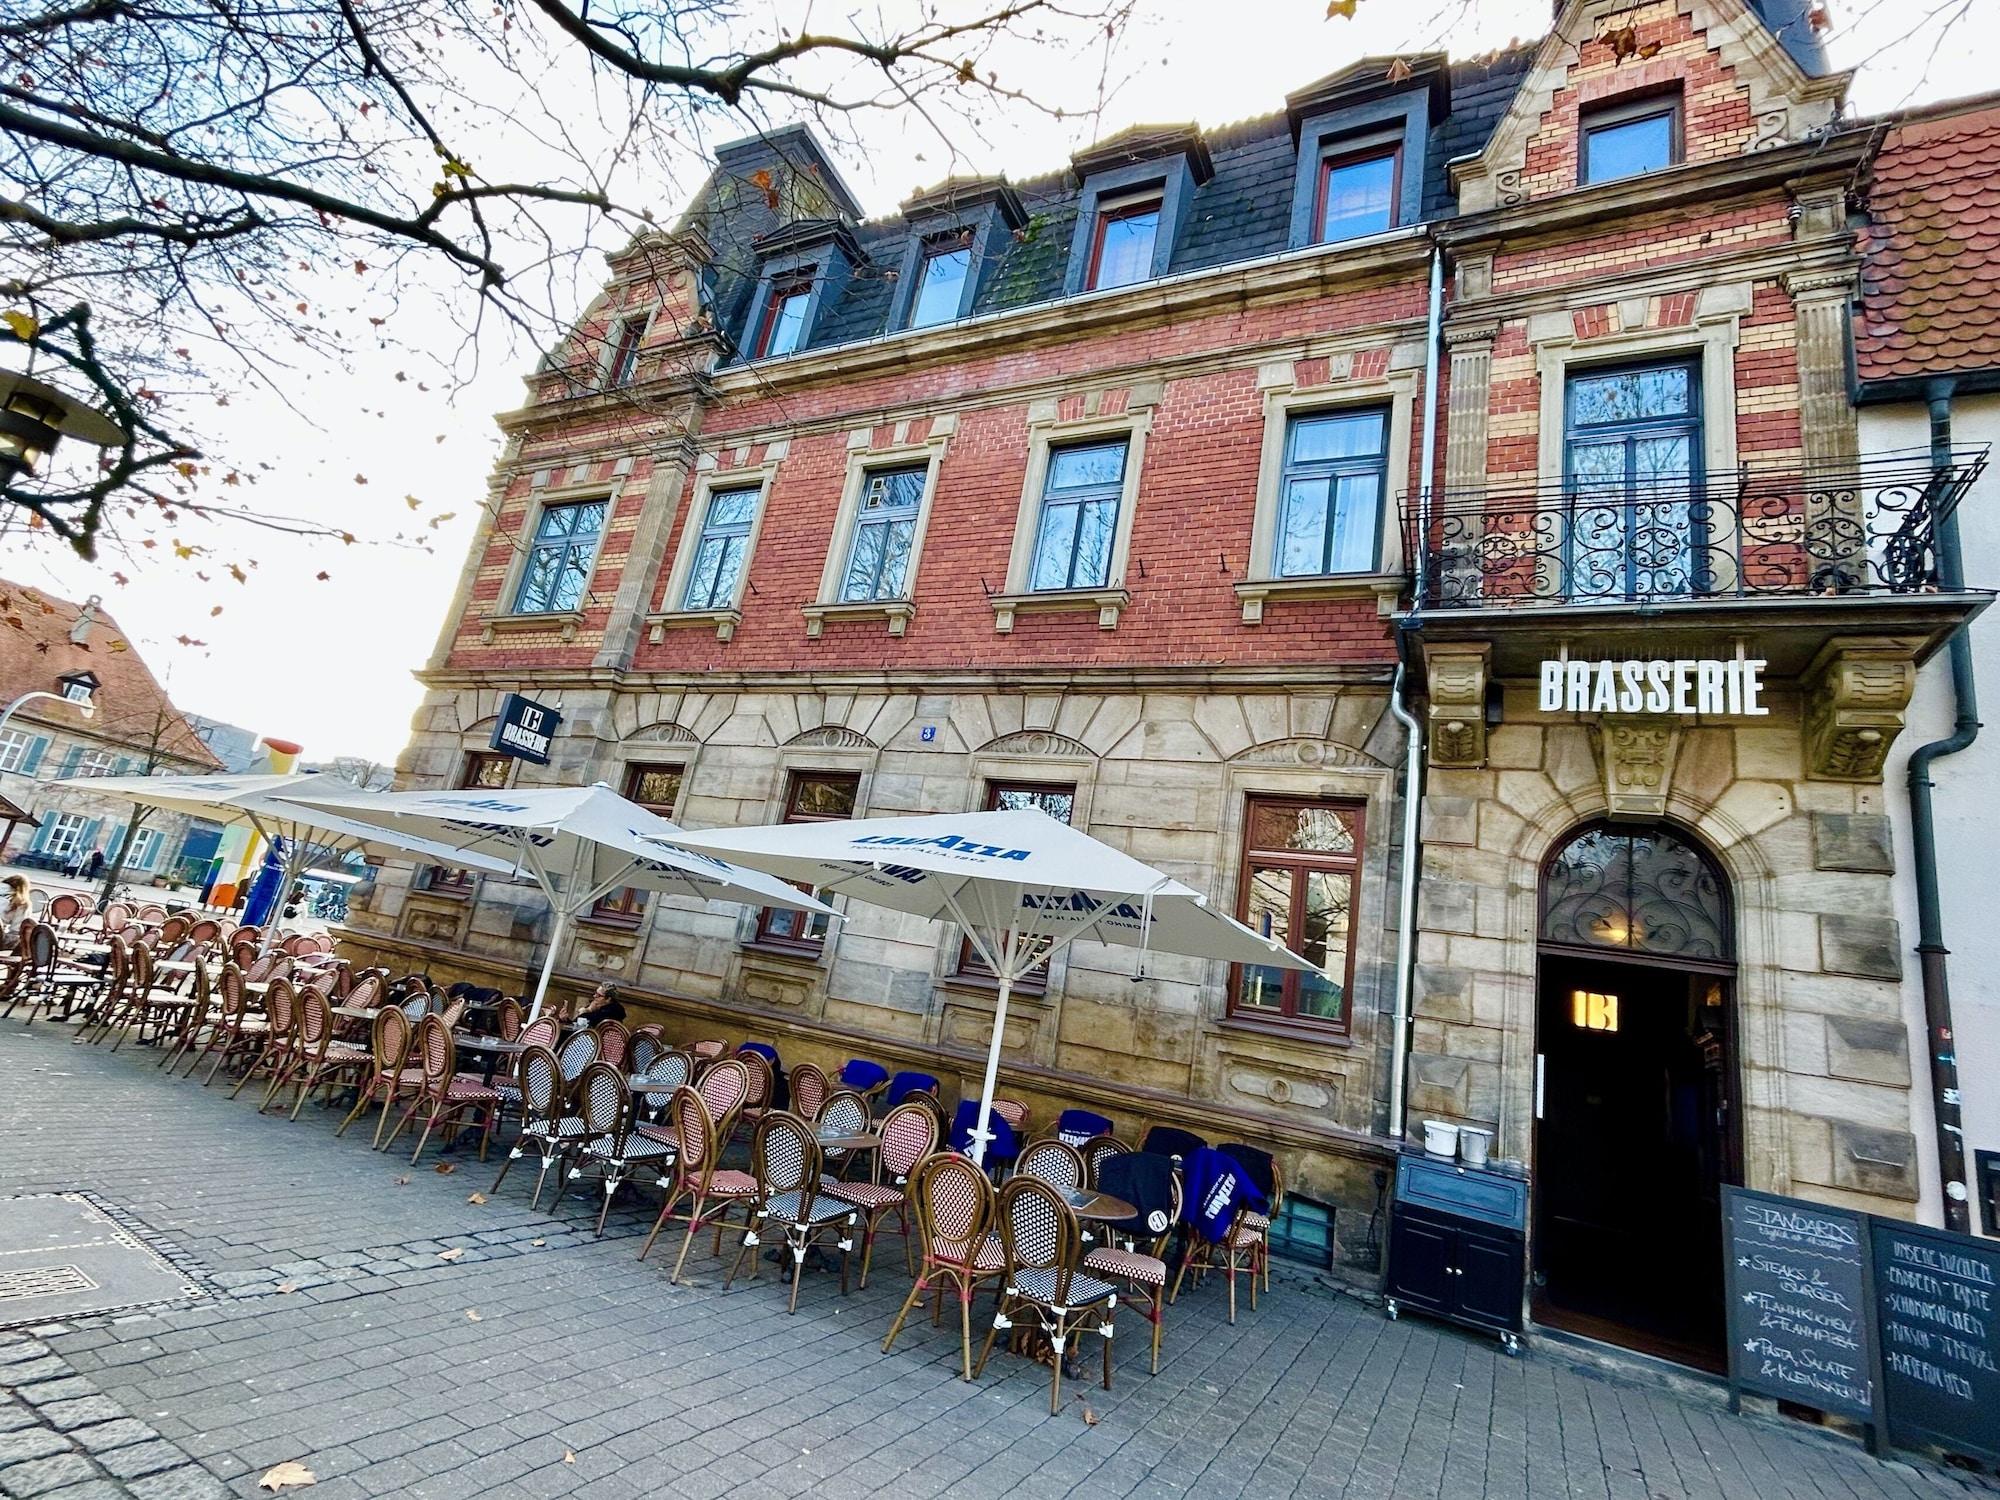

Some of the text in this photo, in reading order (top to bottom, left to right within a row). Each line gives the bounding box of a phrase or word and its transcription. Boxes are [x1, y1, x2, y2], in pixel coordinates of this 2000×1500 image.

[1539, 659, 1769, 715] BRASSERIE
[502, 722, 550, 754] BRASSERIE
[1744, 1205, 1858, 1245] STANDARDS
[1751, 1254, 1829, 1287] STEAKS &
[1778, 1276, 1852, 1312] BURGER
